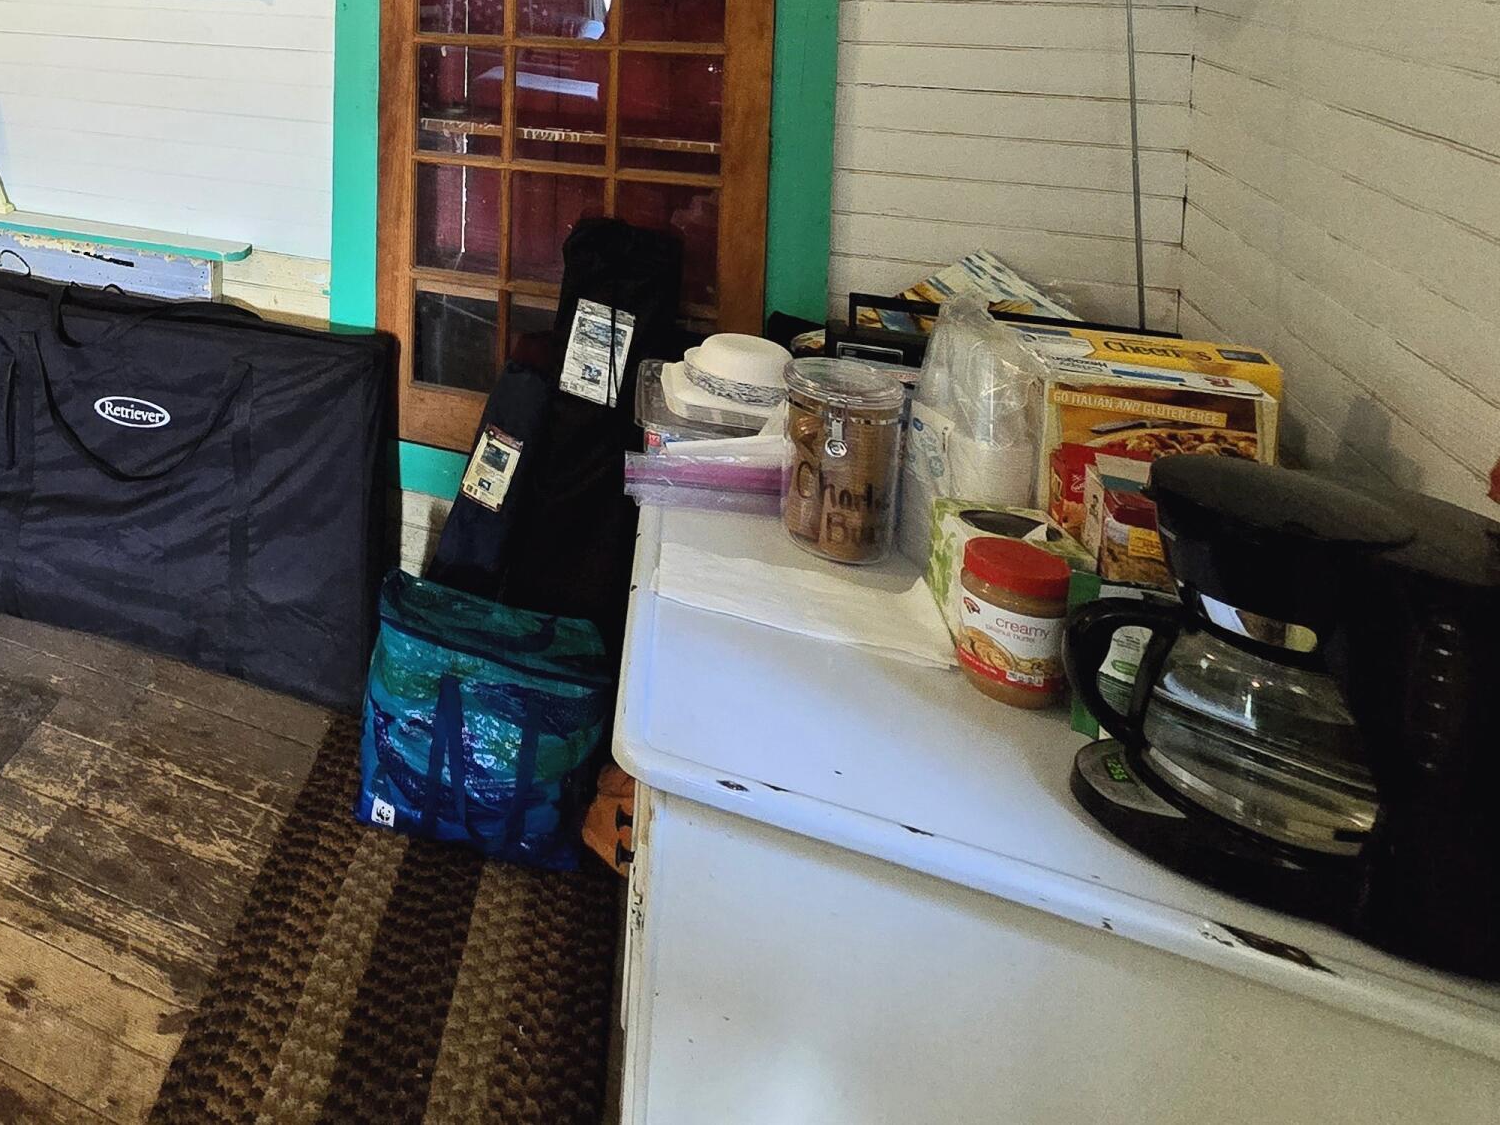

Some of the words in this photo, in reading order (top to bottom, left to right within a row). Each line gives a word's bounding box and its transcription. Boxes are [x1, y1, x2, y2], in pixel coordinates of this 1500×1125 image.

[104, 400, 165, 424] Retriever
[1053, 392, 1069, 403] GO
[1072, 393, 1113, 411] ITALIAN
[1117, 400, 1141, 413] AND
[1143, 403, 1187, 420] GLUTEN
[1190, 410, 1220, 424] FREE
[995, 616, 1051, 638] creamy
